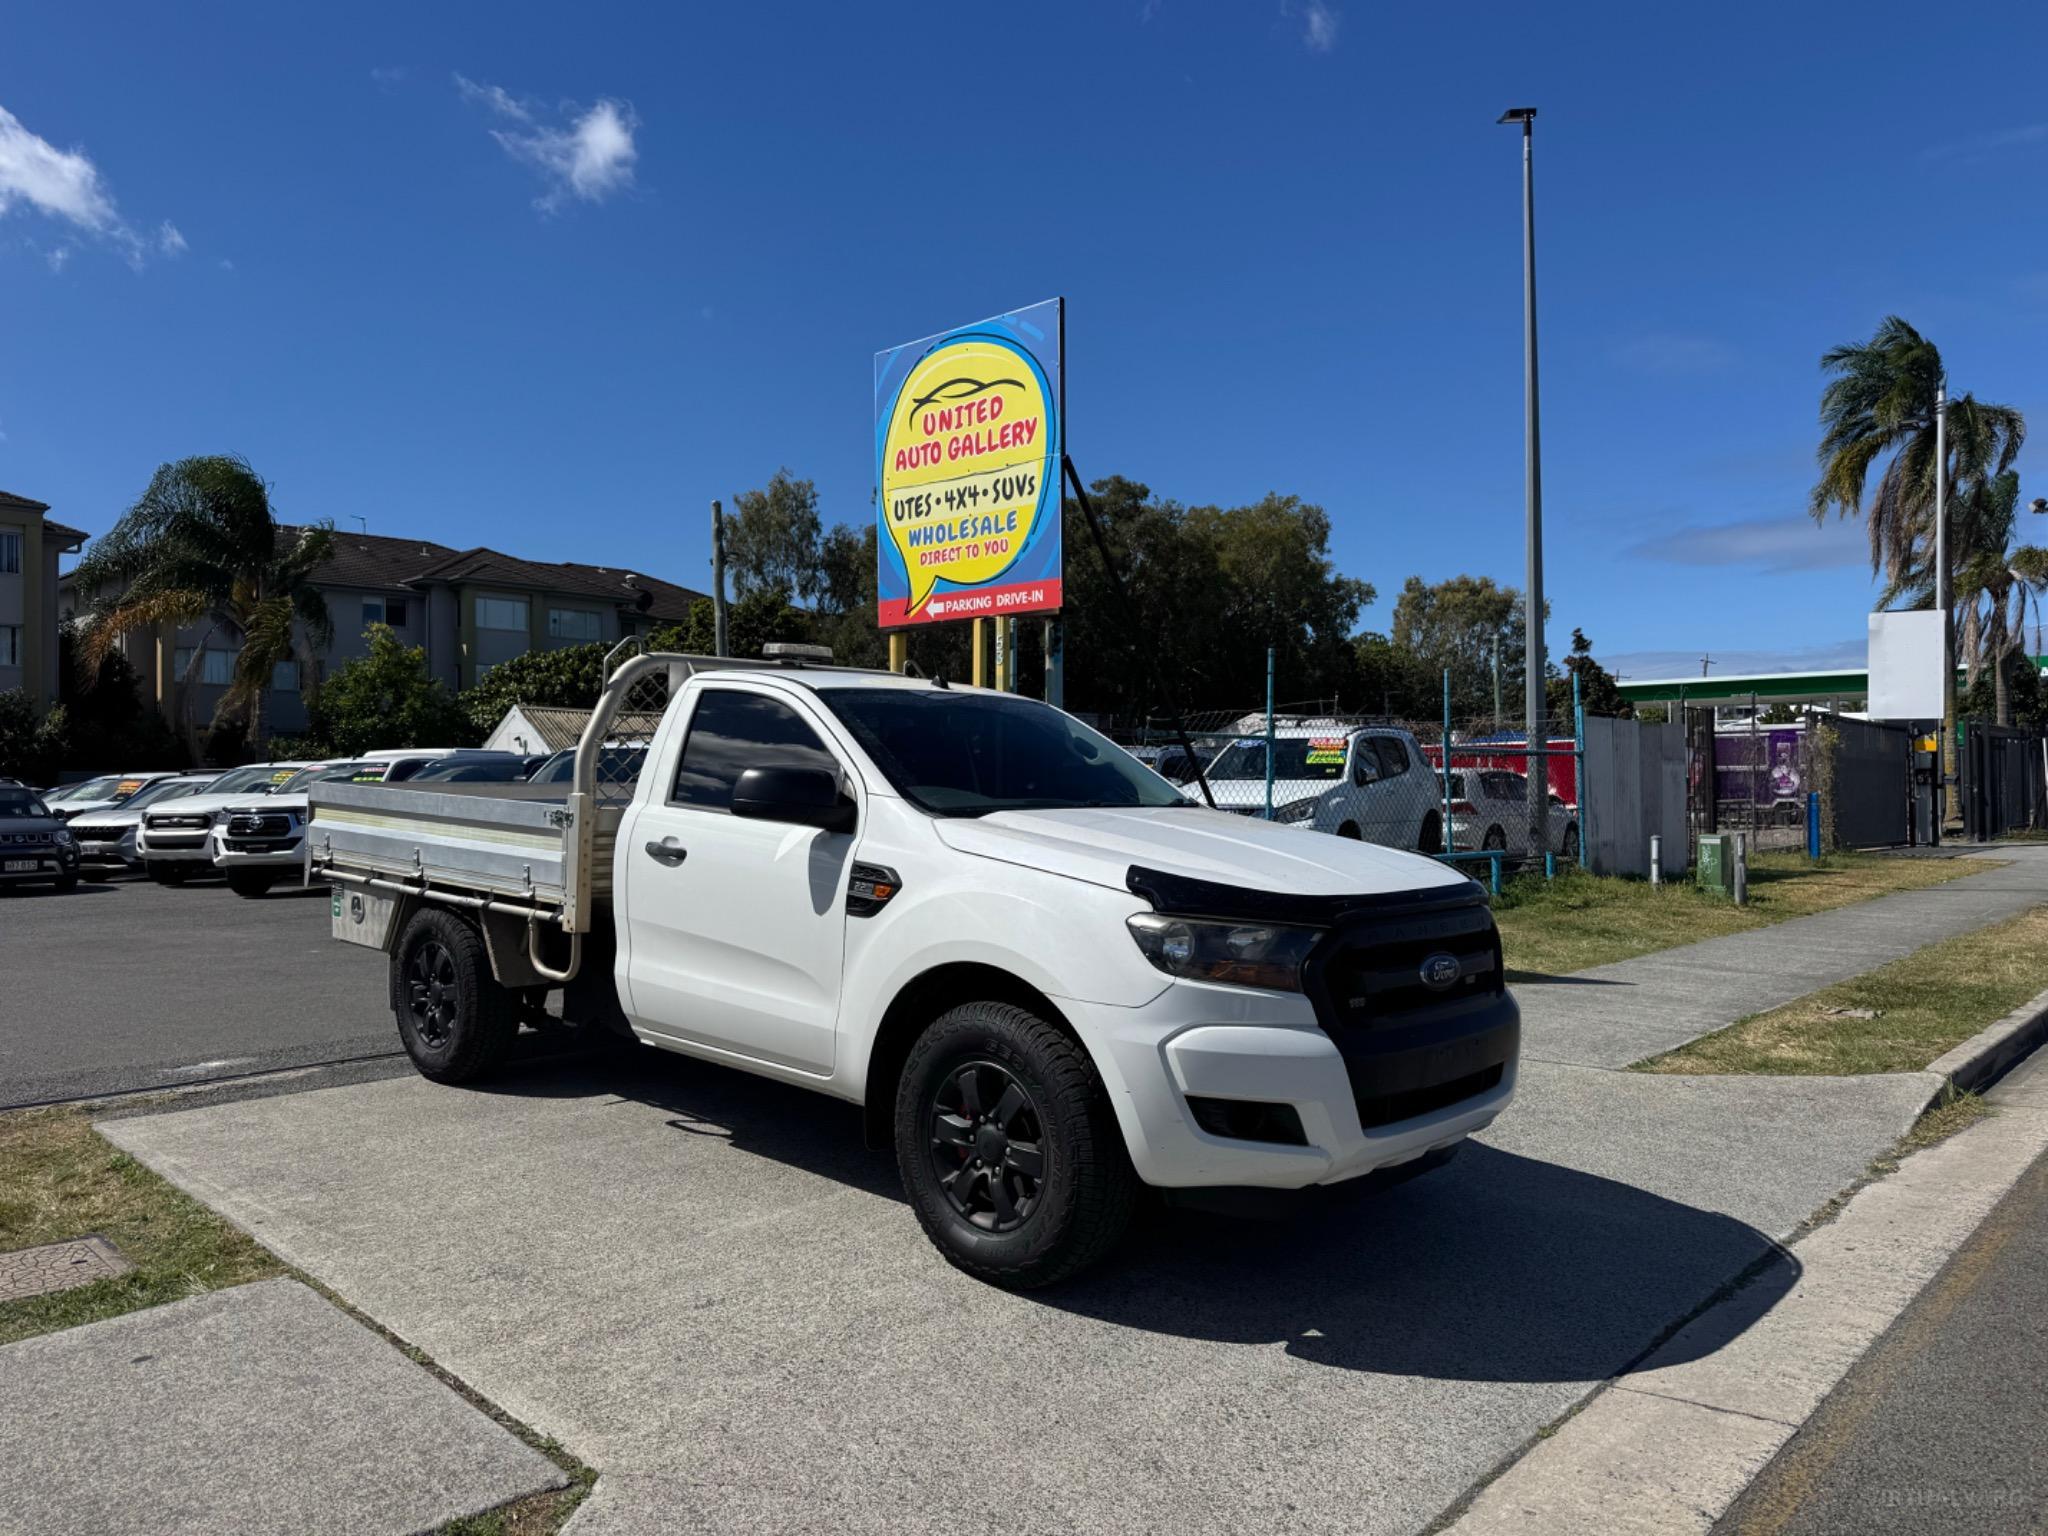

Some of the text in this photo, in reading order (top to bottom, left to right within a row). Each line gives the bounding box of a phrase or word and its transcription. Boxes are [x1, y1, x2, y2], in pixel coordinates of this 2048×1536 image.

[922, 395, 1004, 436] UNITED
[895, 417, 1038, 472] AUTO GALLERY
[894, 493, 932, 522] UTES
[945, 483, 979, 510] 4X4
[908, 510, 1017, 548] WHOLESALE
[920, 538, 1009, 566] DIRECT TO YOU
[945, 589, 1044, 613] PARKING DRIVE-IN
[1433, 961, 1456, 981] Ford
